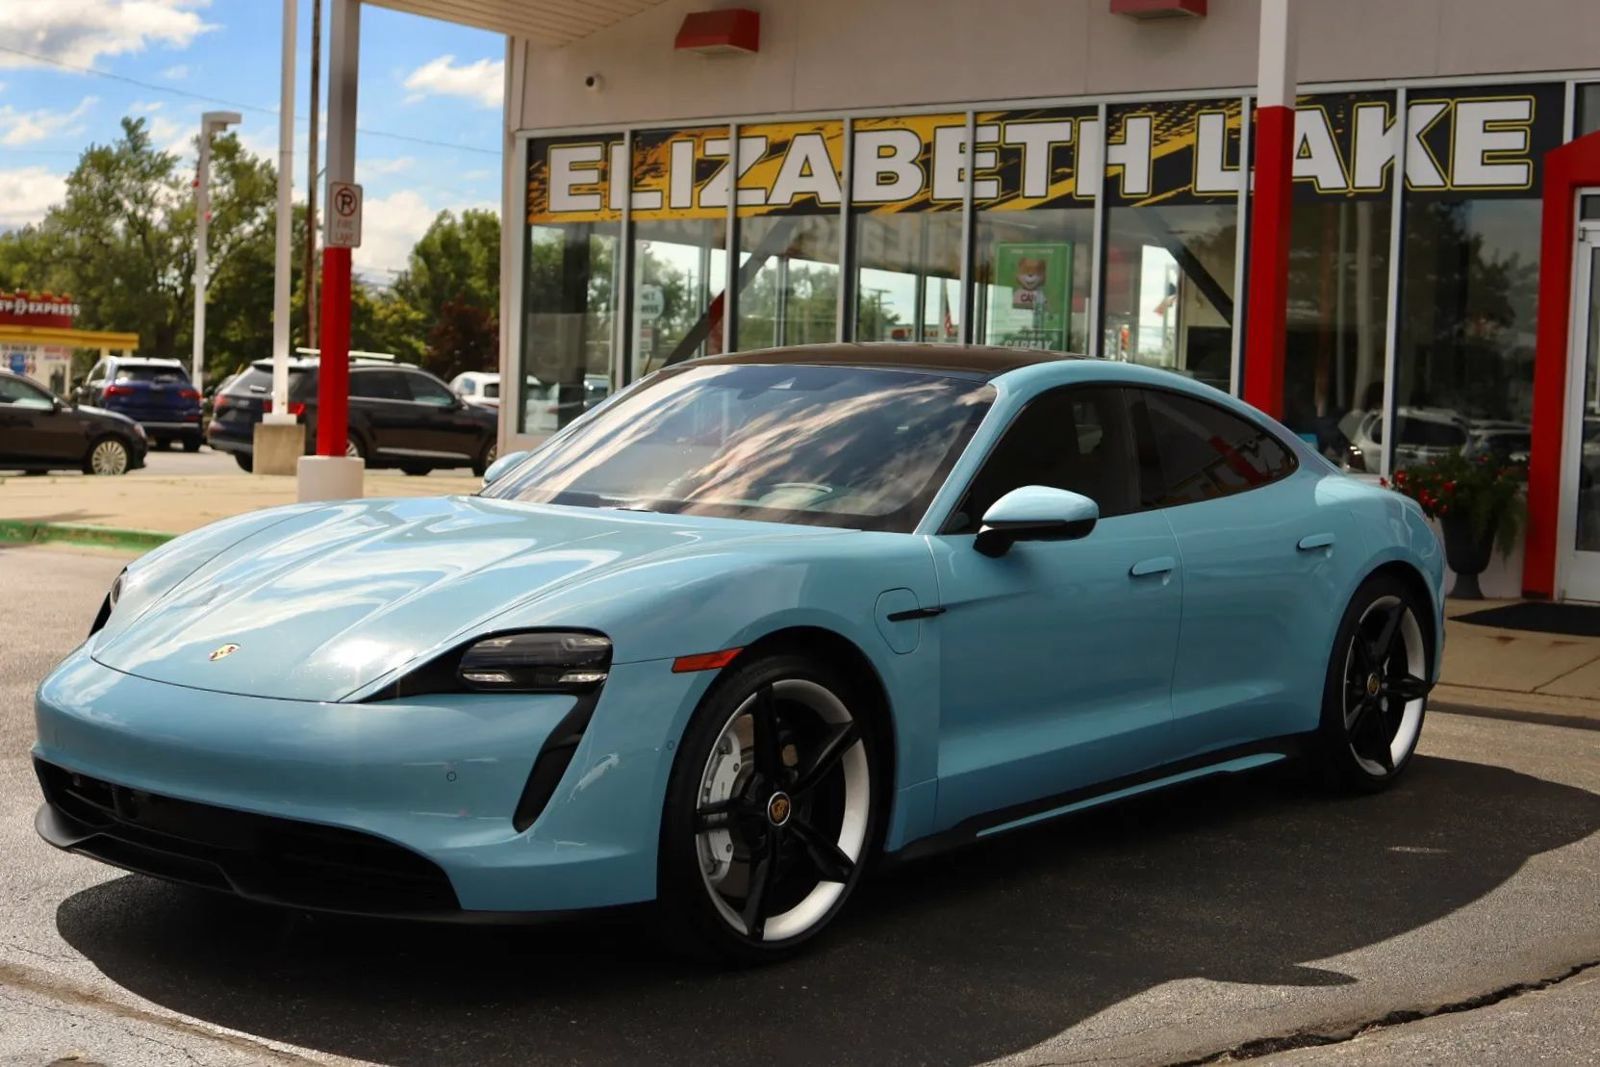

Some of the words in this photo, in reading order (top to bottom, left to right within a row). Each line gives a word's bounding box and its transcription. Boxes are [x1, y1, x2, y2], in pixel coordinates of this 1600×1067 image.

[547, 113, 1153, 212] ELIZABETH
[1193, 96, 1534, 196] LAKE
[28, 302, 81, 316] EXPRESS
